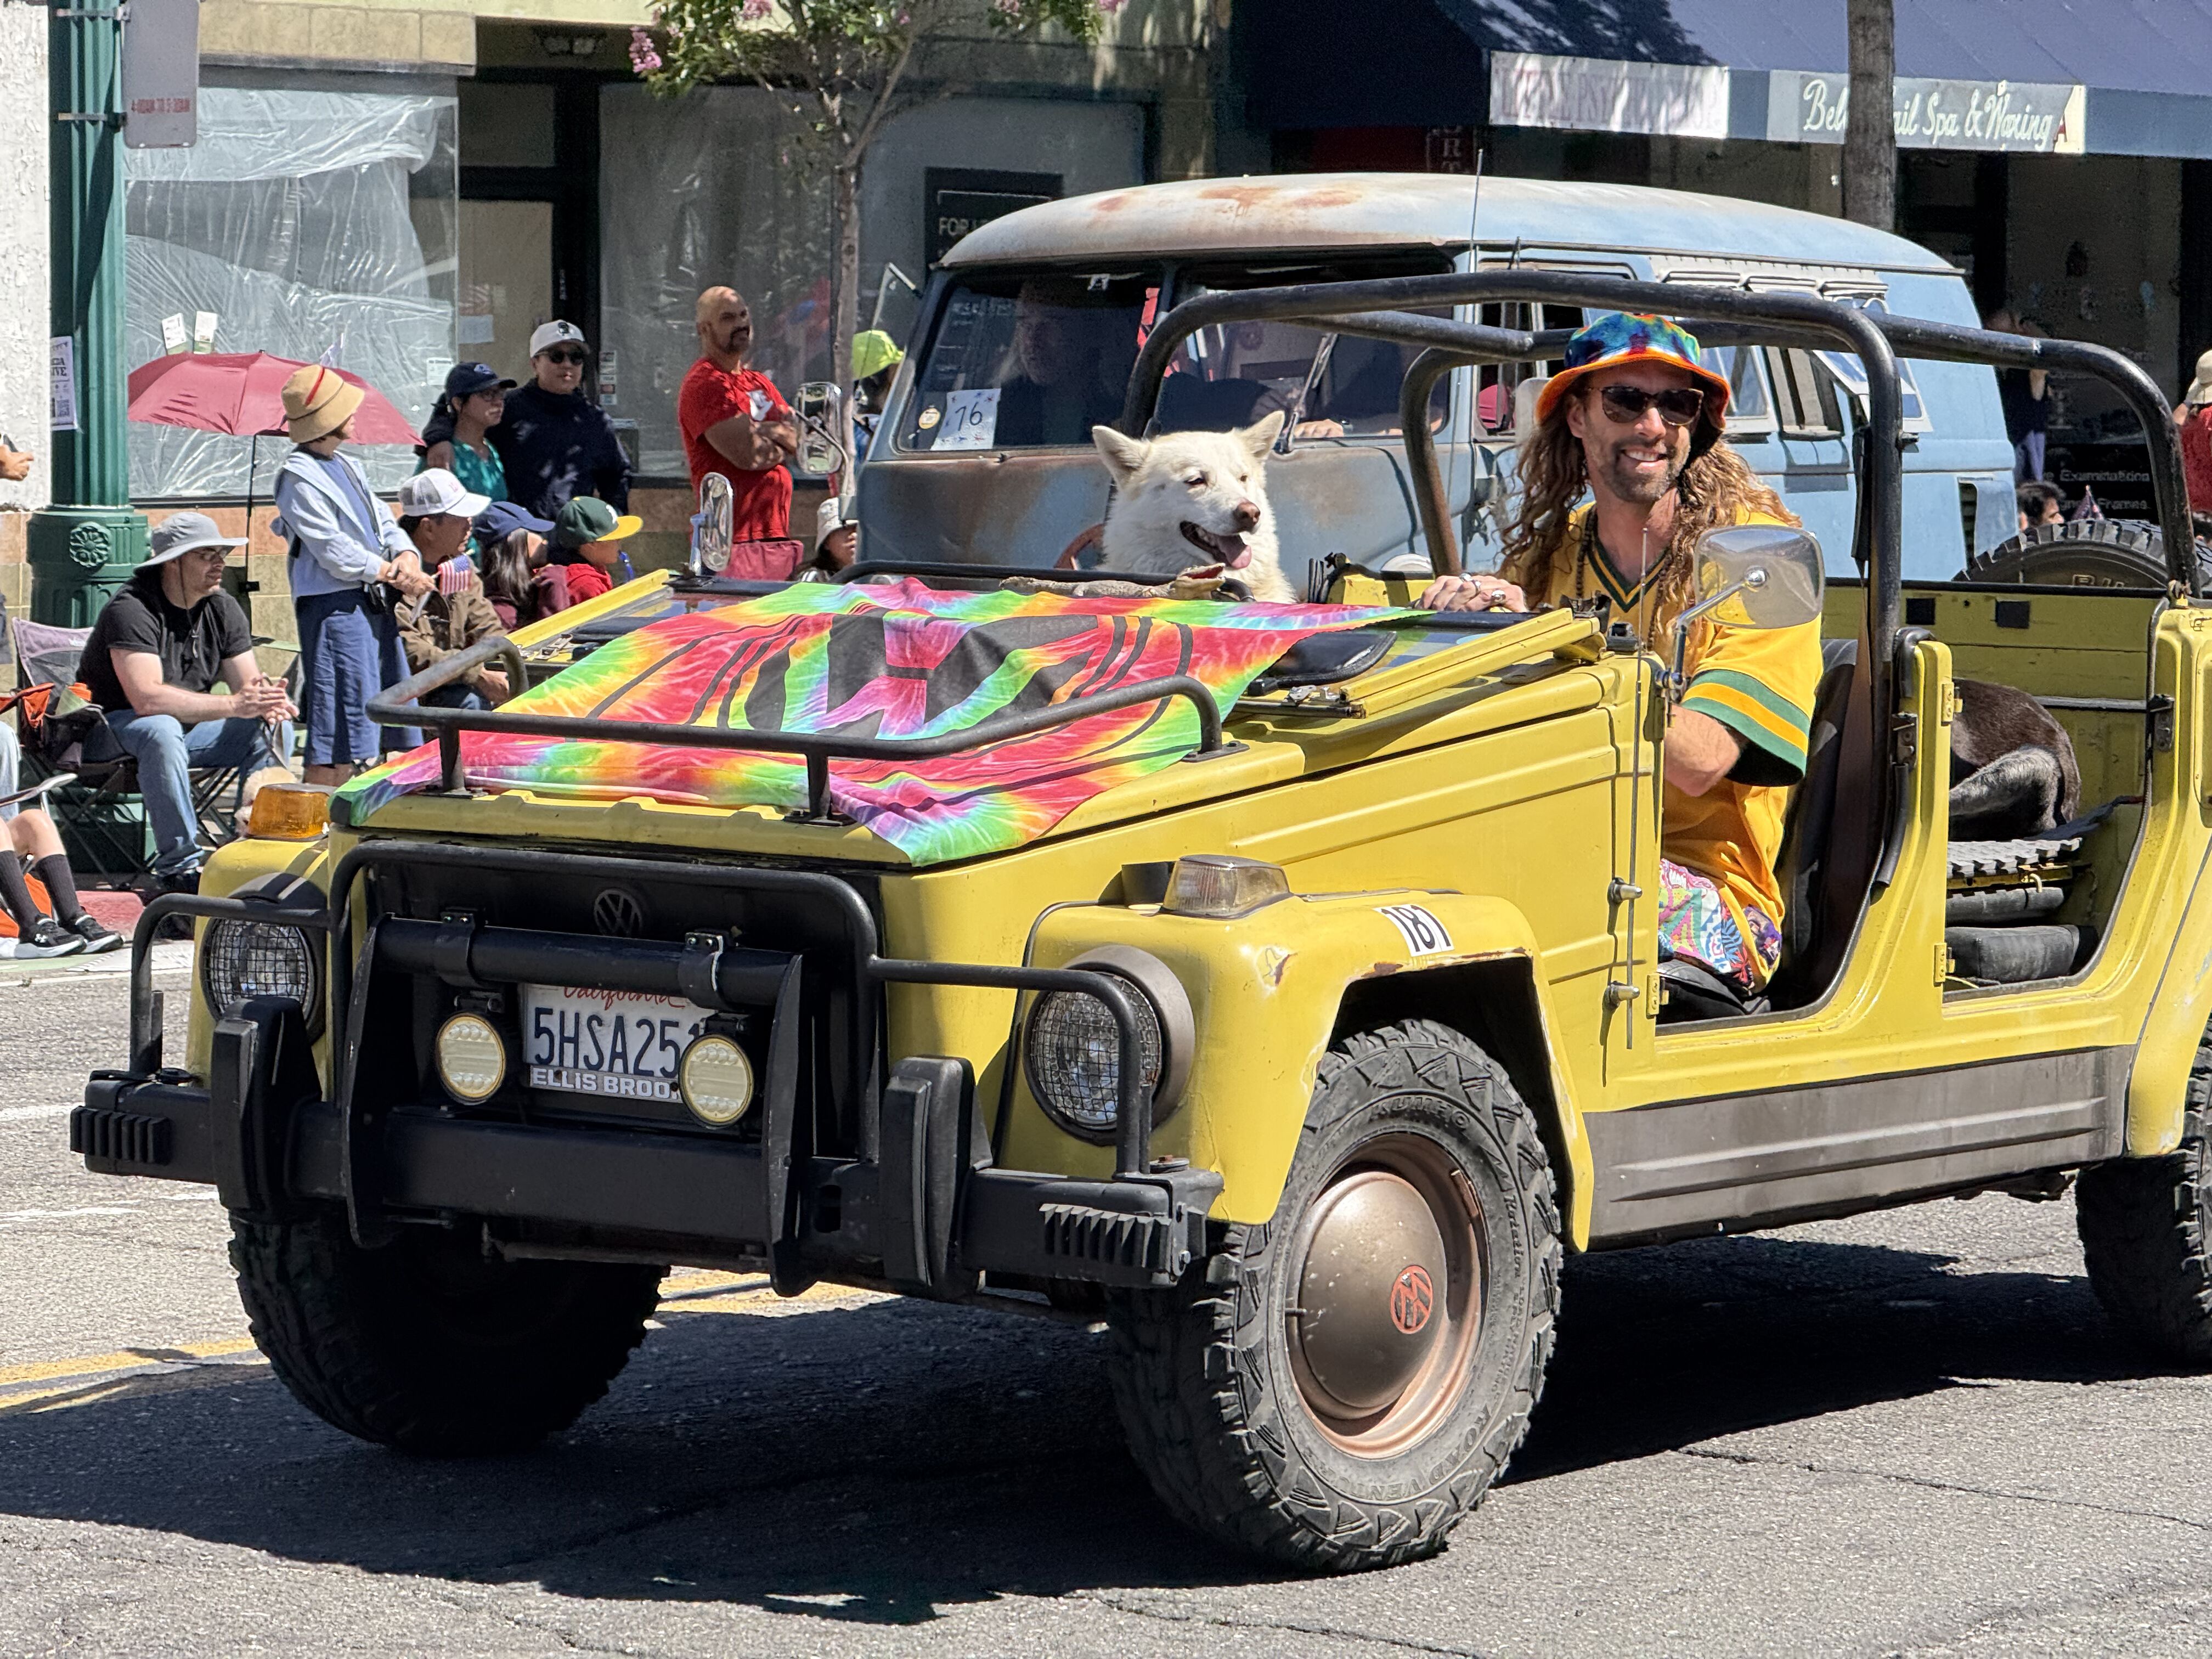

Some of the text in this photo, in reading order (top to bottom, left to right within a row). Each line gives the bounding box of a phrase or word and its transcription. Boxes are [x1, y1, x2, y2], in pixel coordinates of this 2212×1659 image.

[1803, 79, 1849, 132] Bel
[1922, 92, 1959, 145] Spa
[1964, 89, 1984, 137] &
[1984, 92, 2053, 151] Waxing
[1380, 905, 1452, 952] 181
[534, 1007, 700, 1079] 5HSA25
[532, 1067, 598, 1091] ELLIS
[603, 1076, 681, 1101] BROO
[1371, 1097, 1471, 1130] KUMHO
[1429, 1403, 1492, 1484] ROAD
